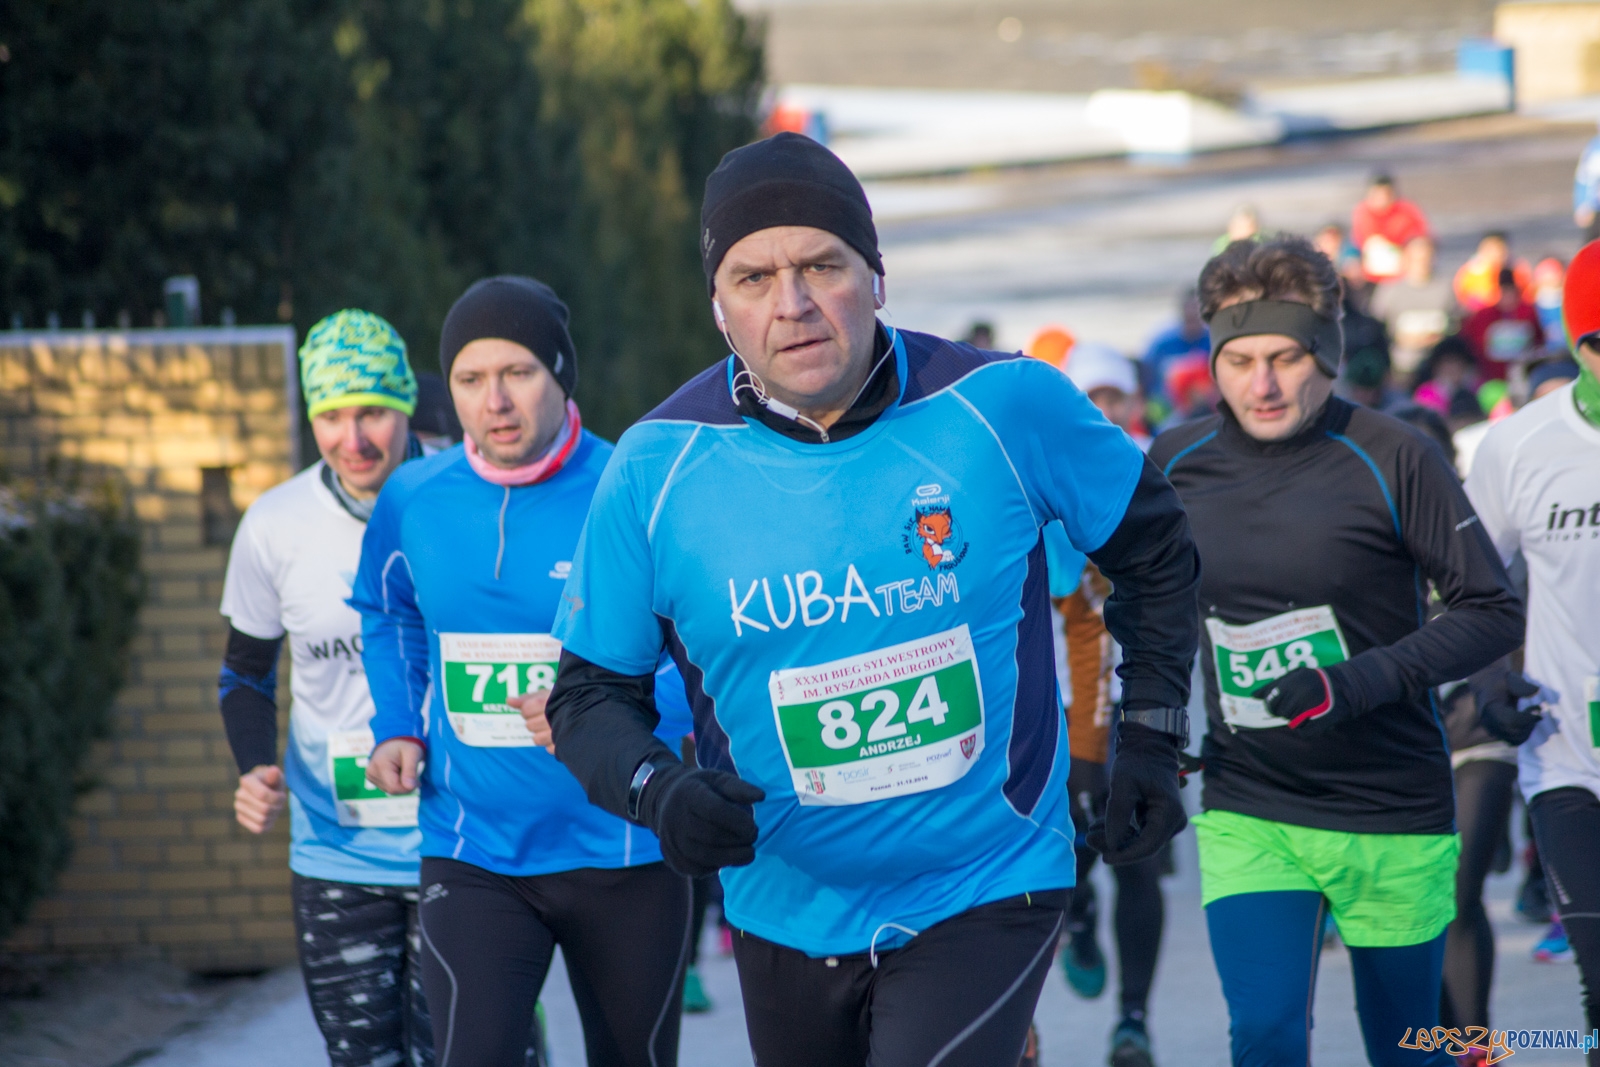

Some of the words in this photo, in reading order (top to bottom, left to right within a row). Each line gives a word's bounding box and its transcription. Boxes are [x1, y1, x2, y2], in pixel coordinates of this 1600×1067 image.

[911, 494, 950, 508] Kalenji
[729, 563, 880, 637] KUBA
[875, 572, 960, 616] TEAM
[465, 664, 557, 703] 718
[795, 672, 830, 687] XXXII
[831, 664, 861, 680] BIEG
[863, 637, 957, 673] SYLWESTROWY
[802, 688, 823, 699] IM.
[825, 672, 891, 696] RYSZARDA
[893, 652, 954, 678] BURGIELA
[1229, 640, 1319, 688] 548
[817, 675, 949, 750] 824
[859, 734, 922, 758] ANDRZEJ
